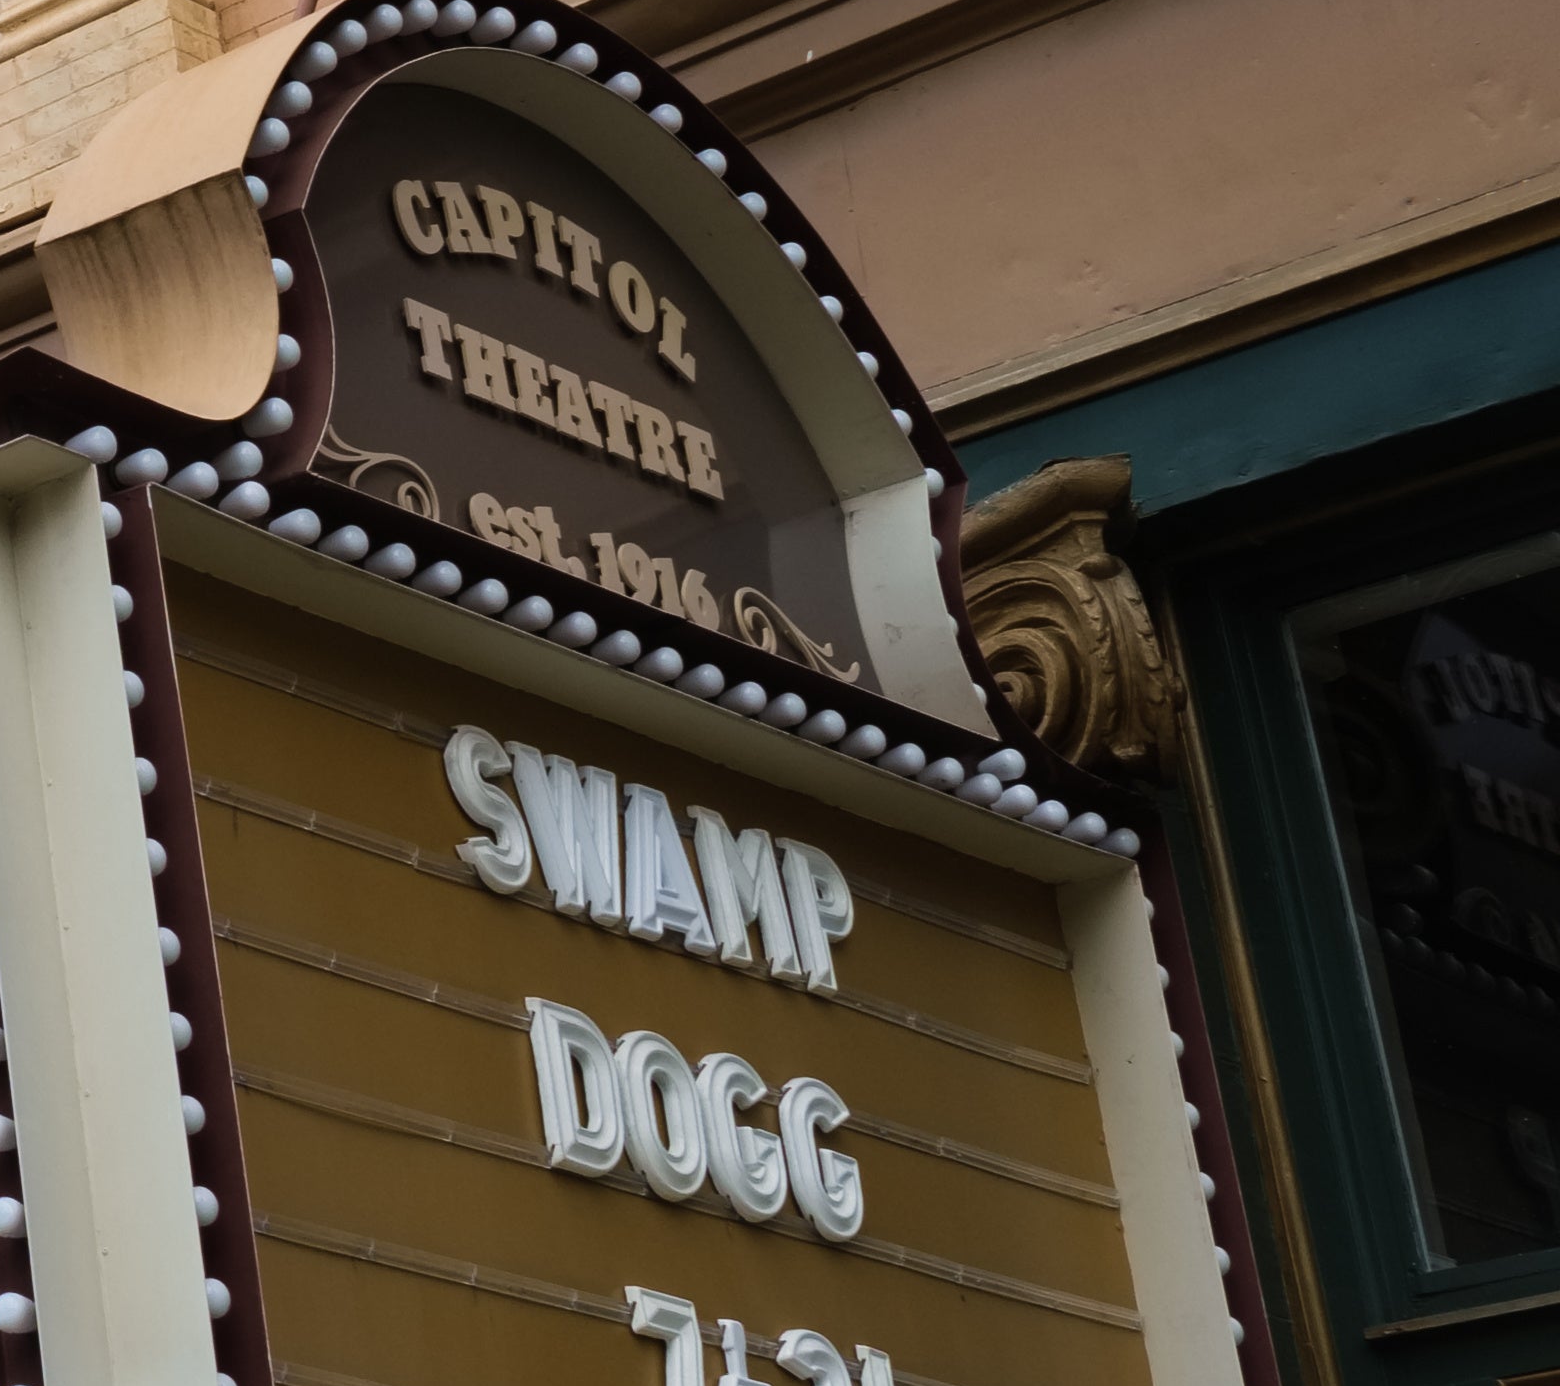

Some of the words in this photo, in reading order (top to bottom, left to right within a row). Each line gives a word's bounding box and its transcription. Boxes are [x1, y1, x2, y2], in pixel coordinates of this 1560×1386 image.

[393, 178, 697, 383] CAPITOL
[404, 298, 725, 501] THEATRE
[469, 492, 587, 582] est.
[590, 532, 720, 627] 1916
[444, 724, 854, 995] SWAMP
[524, 996, 865, 1243] DOGG
